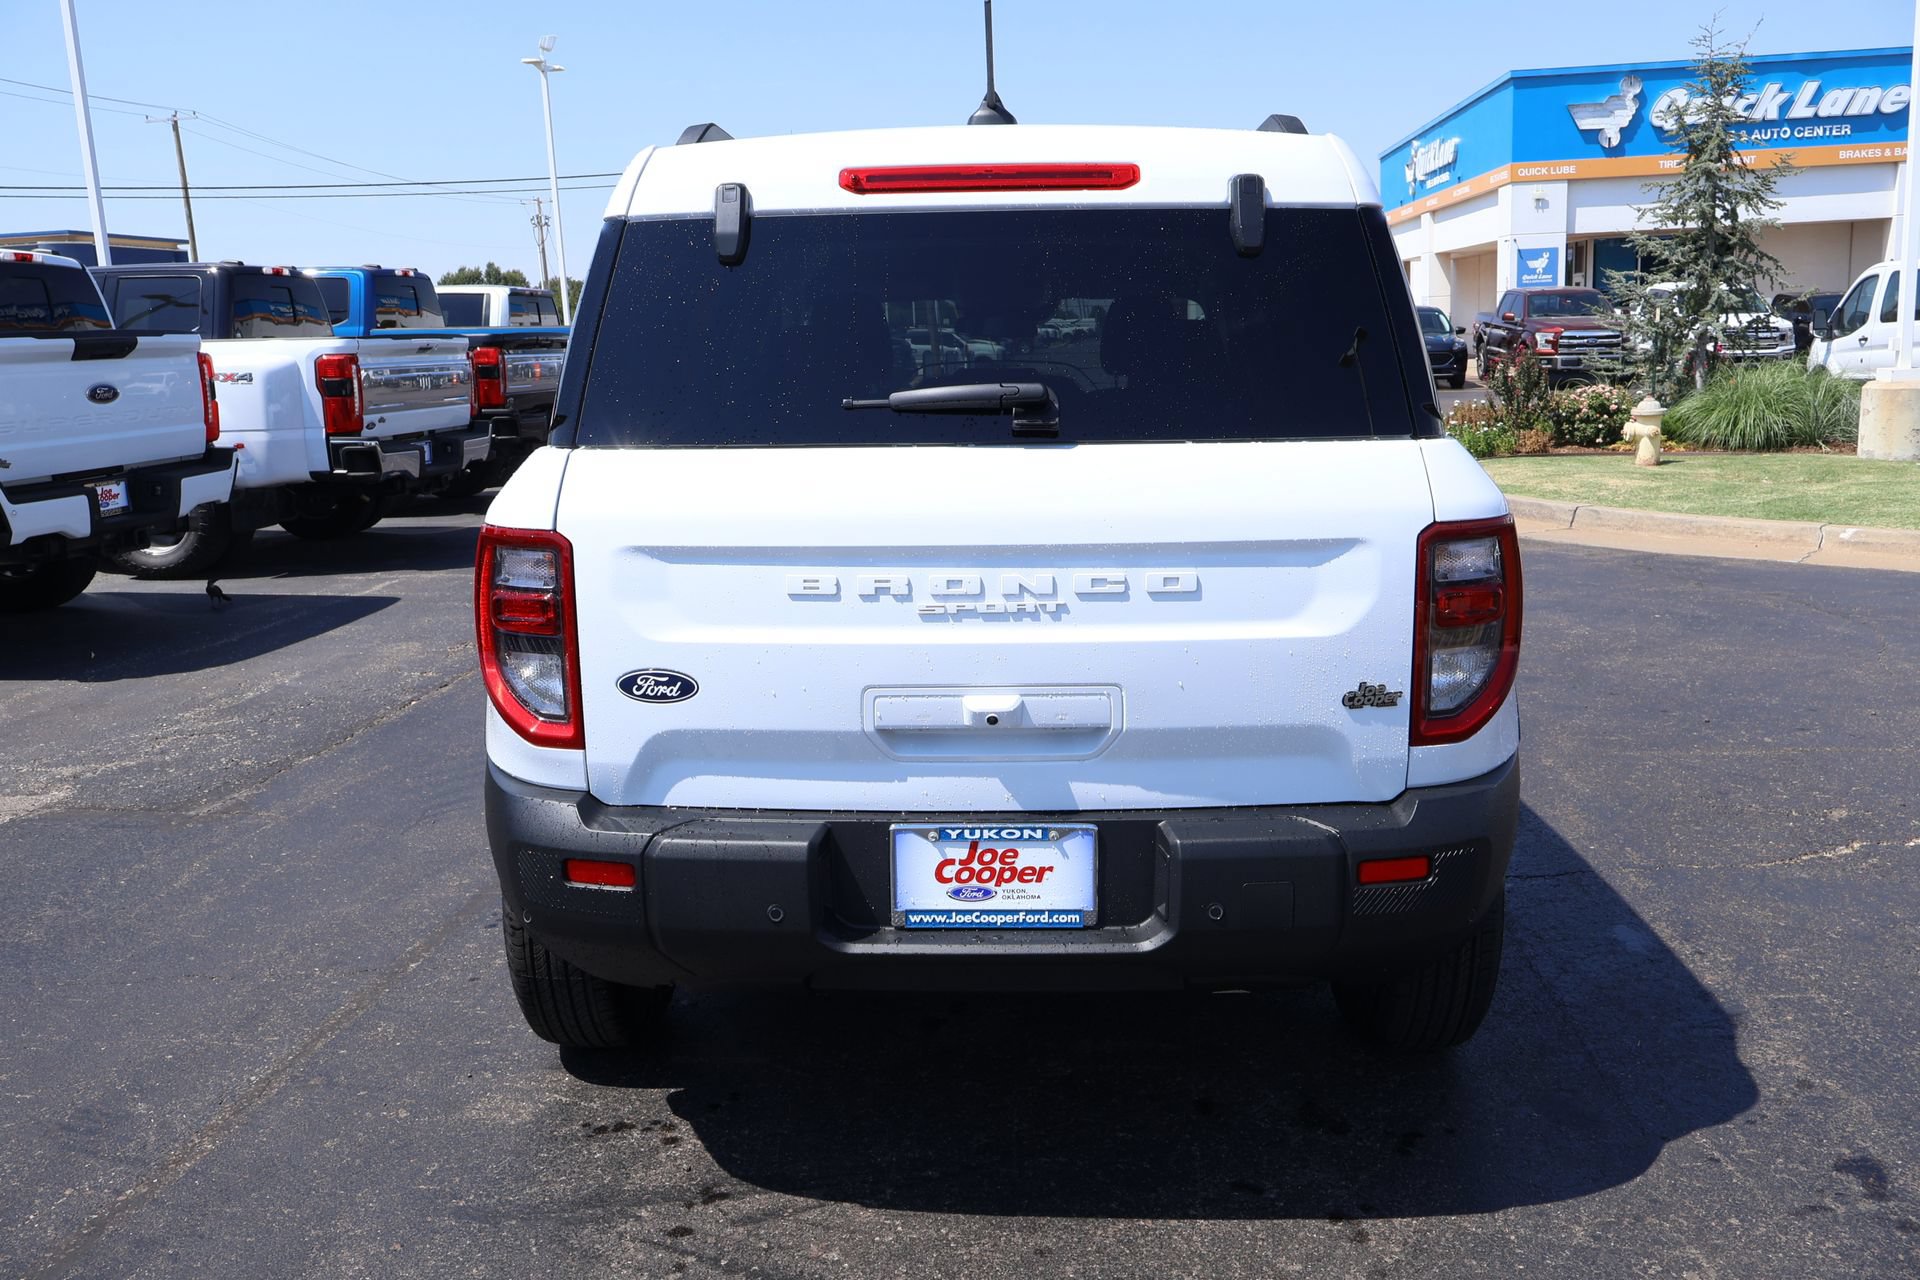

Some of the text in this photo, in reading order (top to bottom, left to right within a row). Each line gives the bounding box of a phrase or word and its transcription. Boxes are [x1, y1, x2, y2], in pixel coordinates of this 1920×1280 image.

[1785, 80, 1911, 119] Lane
[1751, 126, 1791, 141] AUTO
[1794, 124, 1851, 138] CENTER
[1839, 148, 1881, 159] BRAKES
[1884, 148, 1892, 157] &
[1517, 166, 1549, 177] QUICK
[1550, 165, 1577, 175] LUBE
[96, 387, 114, 400] Ford
[785, 572, 1202, 600] BRONCO
[917, 601, 1068, 619] SPORT
[632, 674, 682, 697] Ford
[1358, 681, 1387, 697] Joe
[1341, 690, 1404, 708] Cooper
[945, 828, 1043, 839] YUKON
[958, 841, 1019, 867] Joe
[934, 858, 1054, 887] Cooper
[959, 887, 984, 898] Ford
[908, 911, 1080, 925] www.JoeCooperFord.com
